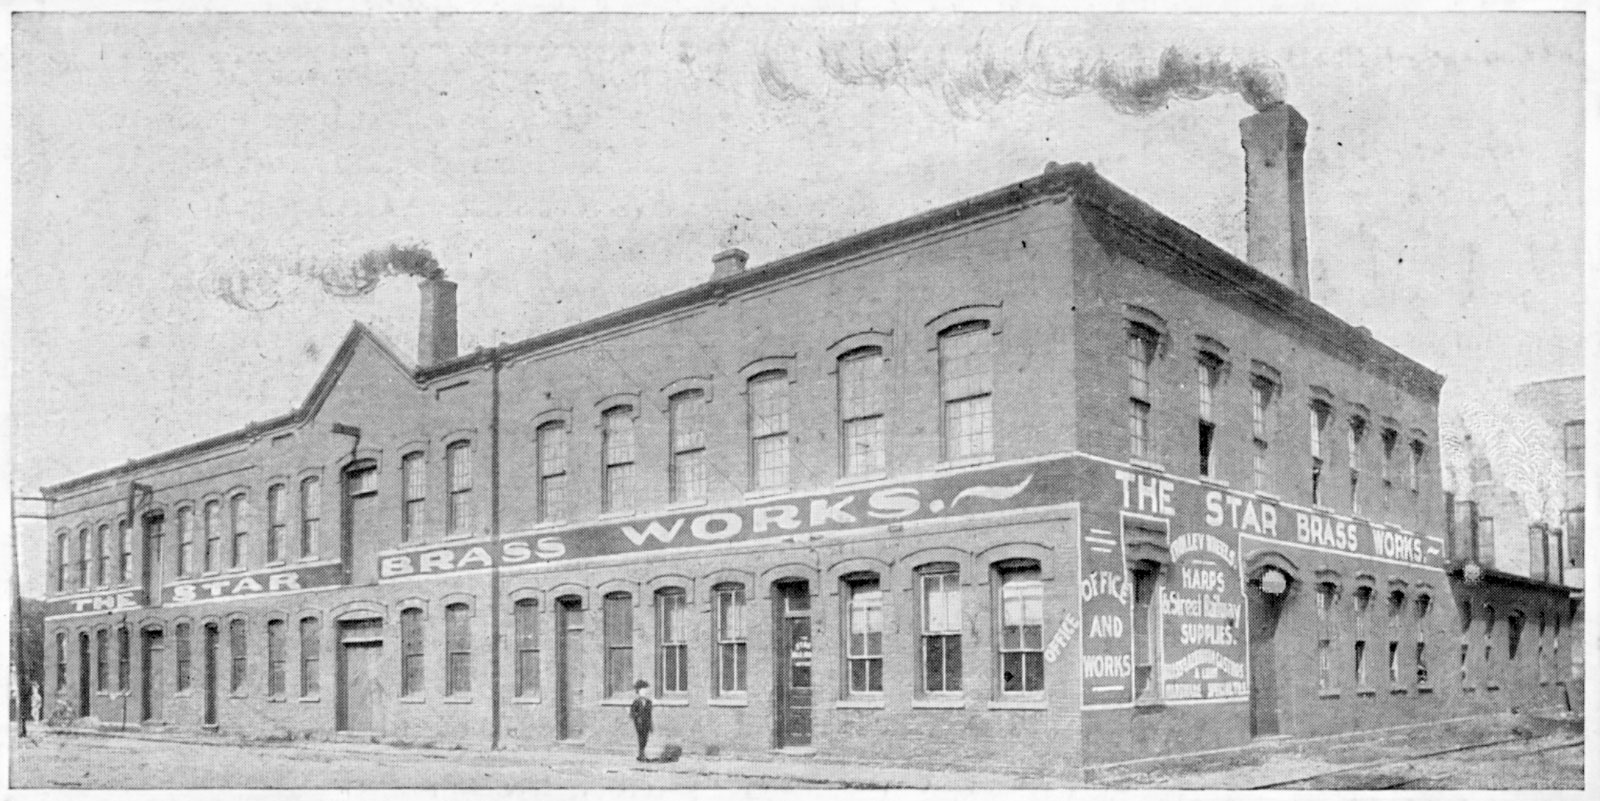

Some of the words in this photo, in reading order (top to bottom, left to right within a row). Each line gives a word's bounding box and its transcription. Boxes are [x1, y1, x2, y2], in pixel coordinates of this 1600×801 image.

[1115, 469, 1175, 516] THE
[1206, 490, 1277, 537] STAR
[1297, 512, 1358, 551] BRASS
[70, 592, 137, 611] THE
[172, 572, 300, 602] STAR
[381, 536, 566, 578] BRASS
[621, 486, 945, 546] WORKS.
[1081, 571, 1130, 605] OFFICE
[1182, 566, 1225, 593] HARPS
[1044, 613, 1079, 663] OFFICE
[1089, 614, 1124, 639] AND
[1082, 653, 1131, 677] WORKS
